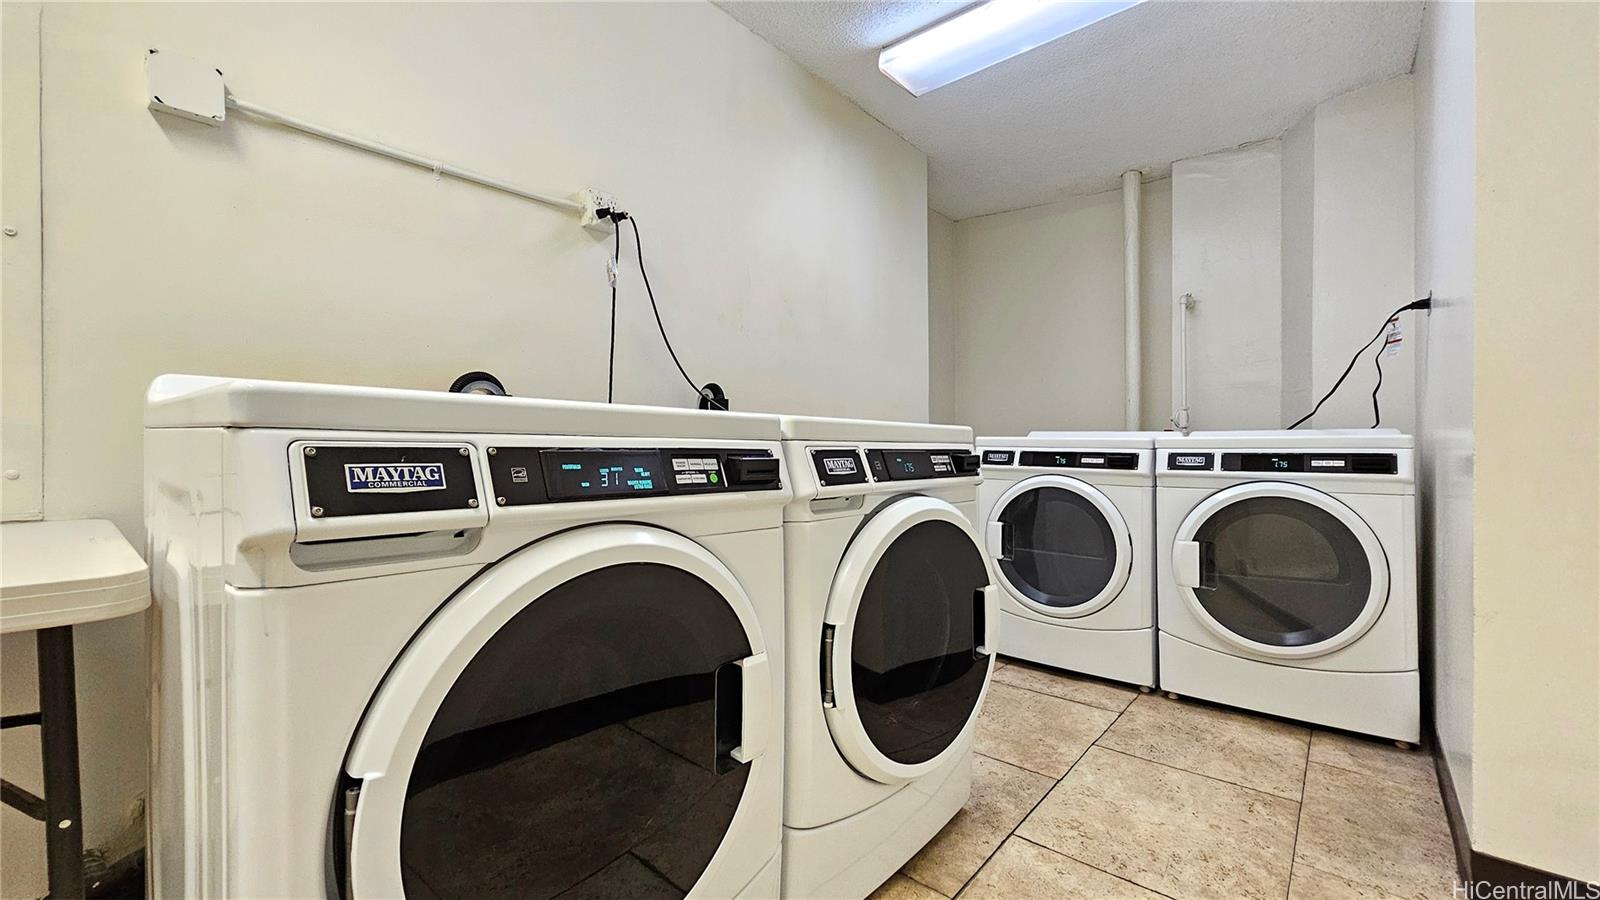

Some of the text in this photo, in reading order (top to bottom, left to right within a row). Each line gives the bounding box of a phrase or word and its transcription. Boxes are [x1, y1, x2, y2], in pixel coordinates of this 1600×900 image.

[826, 460, 854, 469] MAYTAG
[352, 466, 440, 482] MAYTAG
[368, 480, 427, 488] COMMERCIAL
